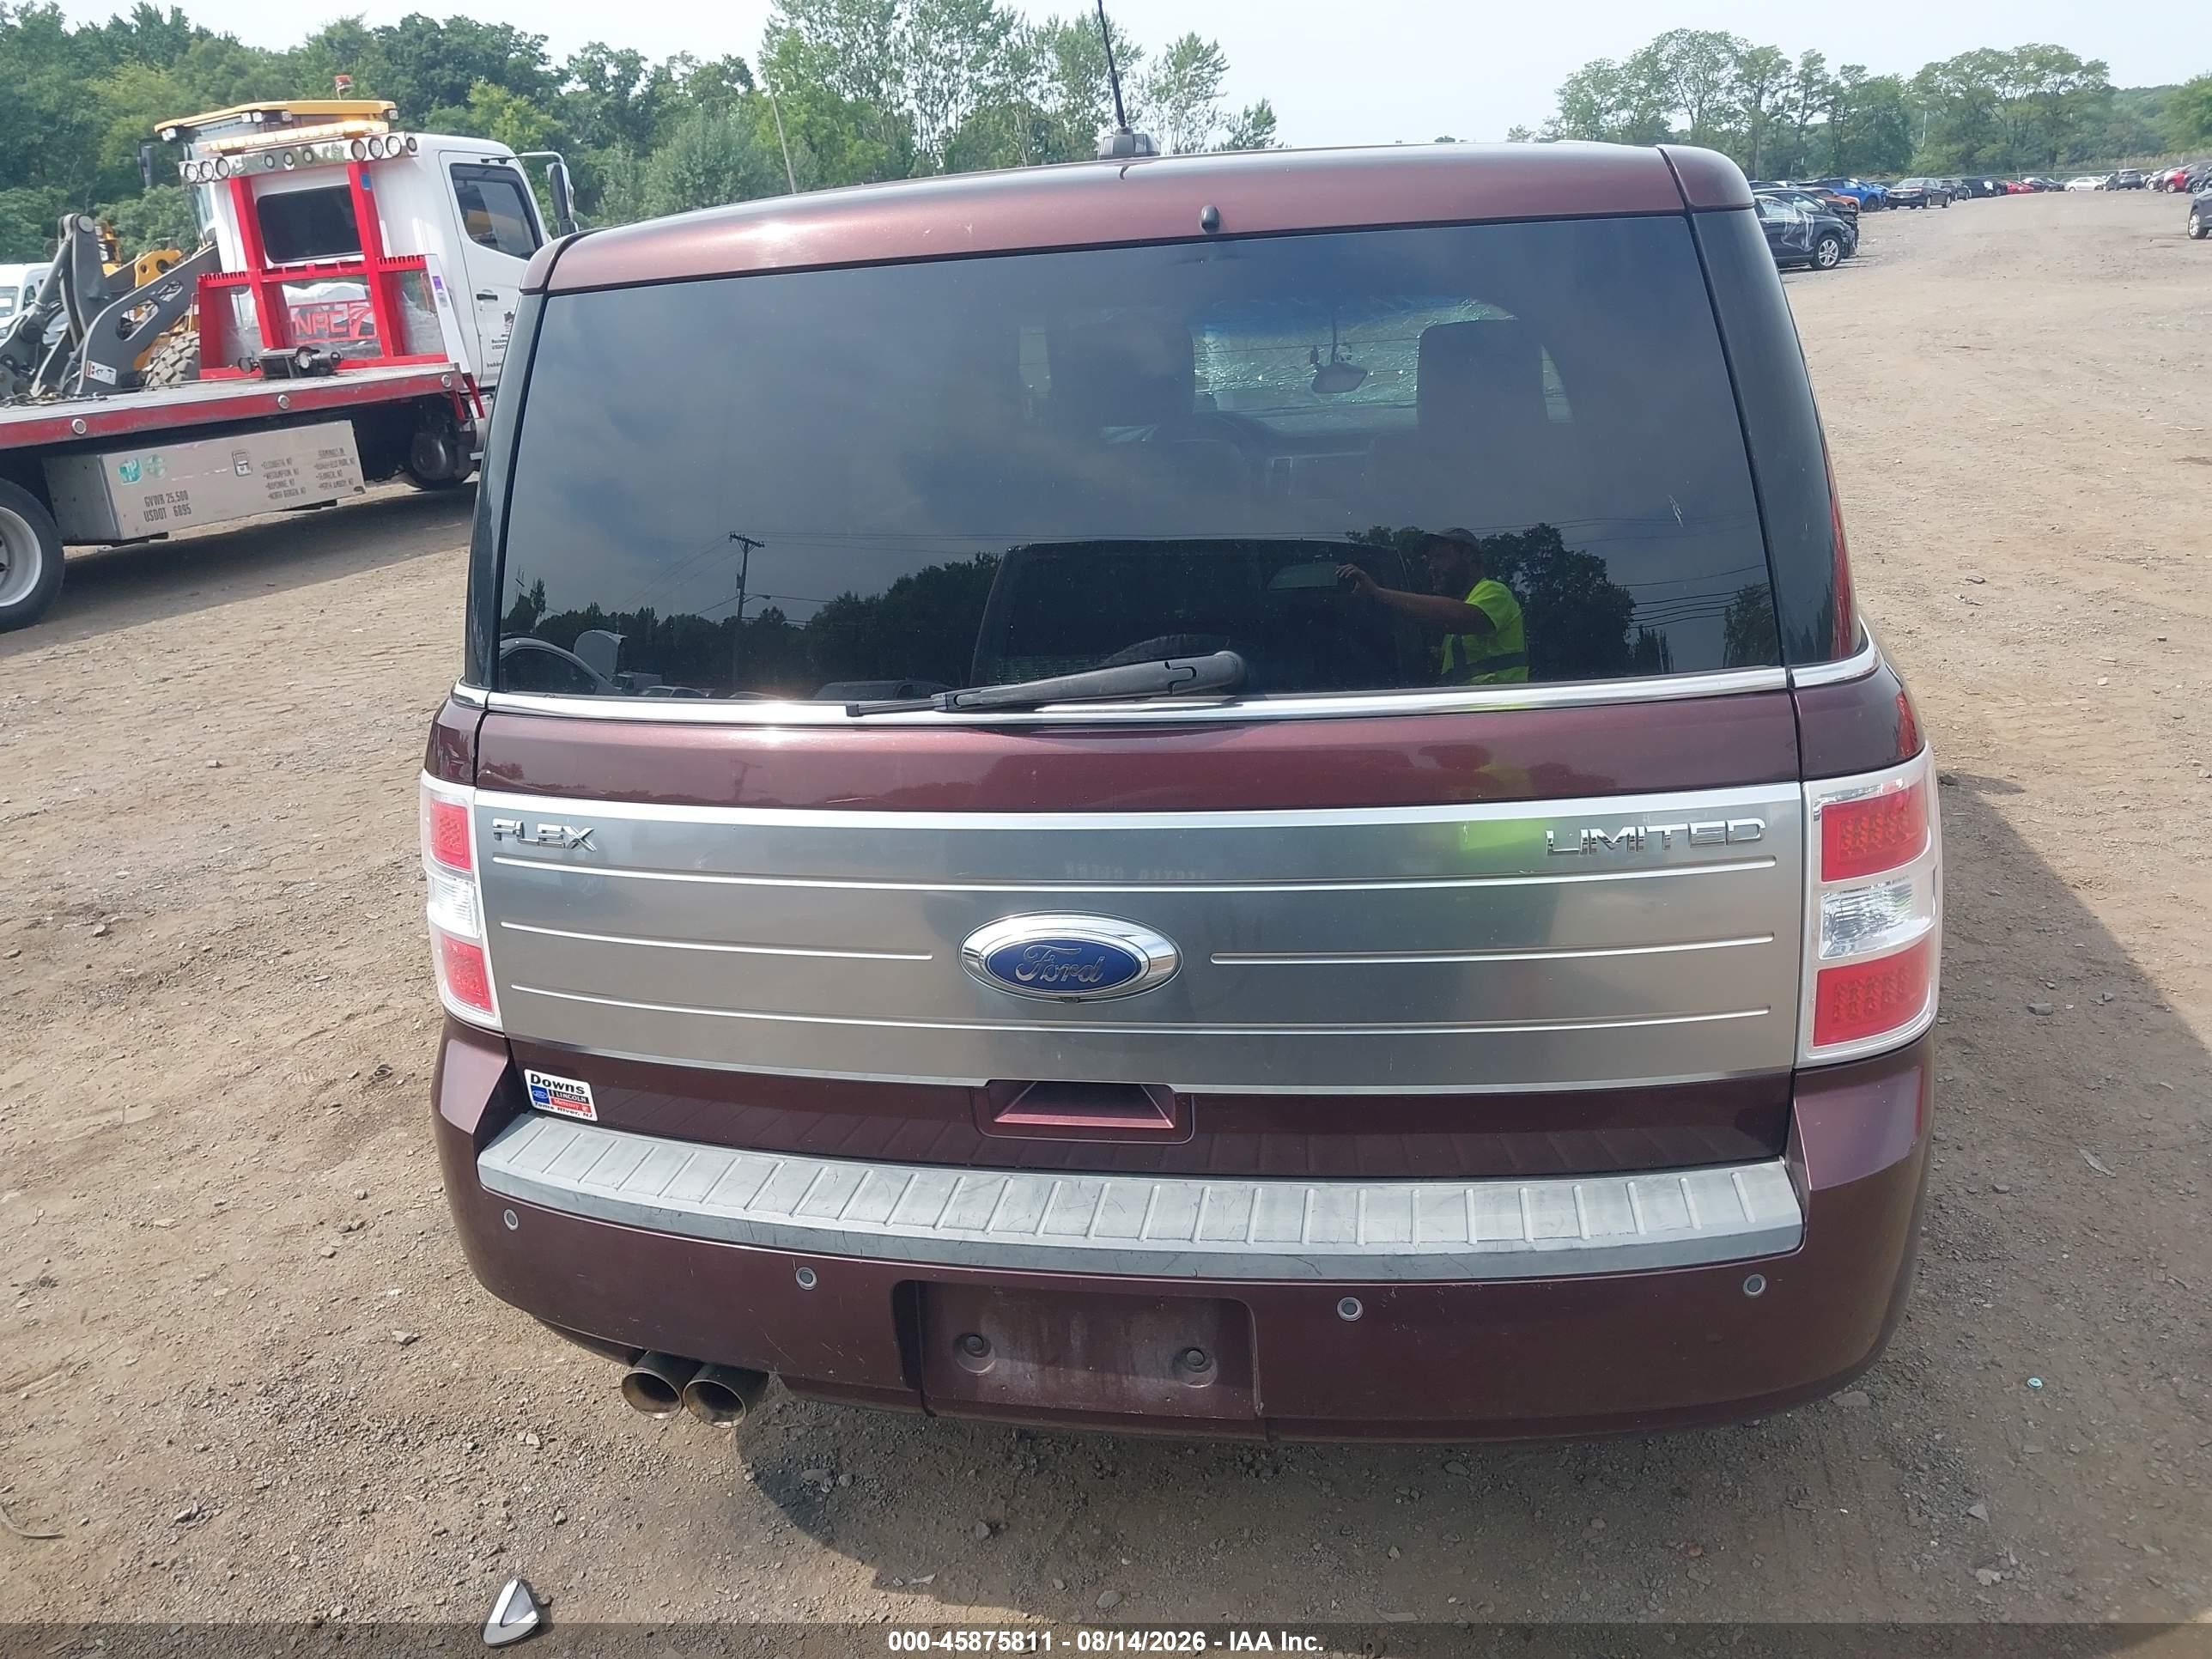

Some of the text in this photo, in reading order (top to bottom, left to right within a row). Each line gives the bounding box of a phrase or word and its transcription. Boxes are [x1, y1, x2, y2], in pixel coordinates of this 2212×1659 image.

[143, 494, 166, 507] GVWR
[143, 507, 167, 523] USDOT
[493, 817, 597, 852] FLEX
[1546, 817, 1766, 856] LIMITED
[1015, 945, 1106, 982] Ford
[530, 1073, 586, 1095] Downs
[535, 1102, 555, 1110] Toms
[556, 1091, 586, 1103] LINCOLN
